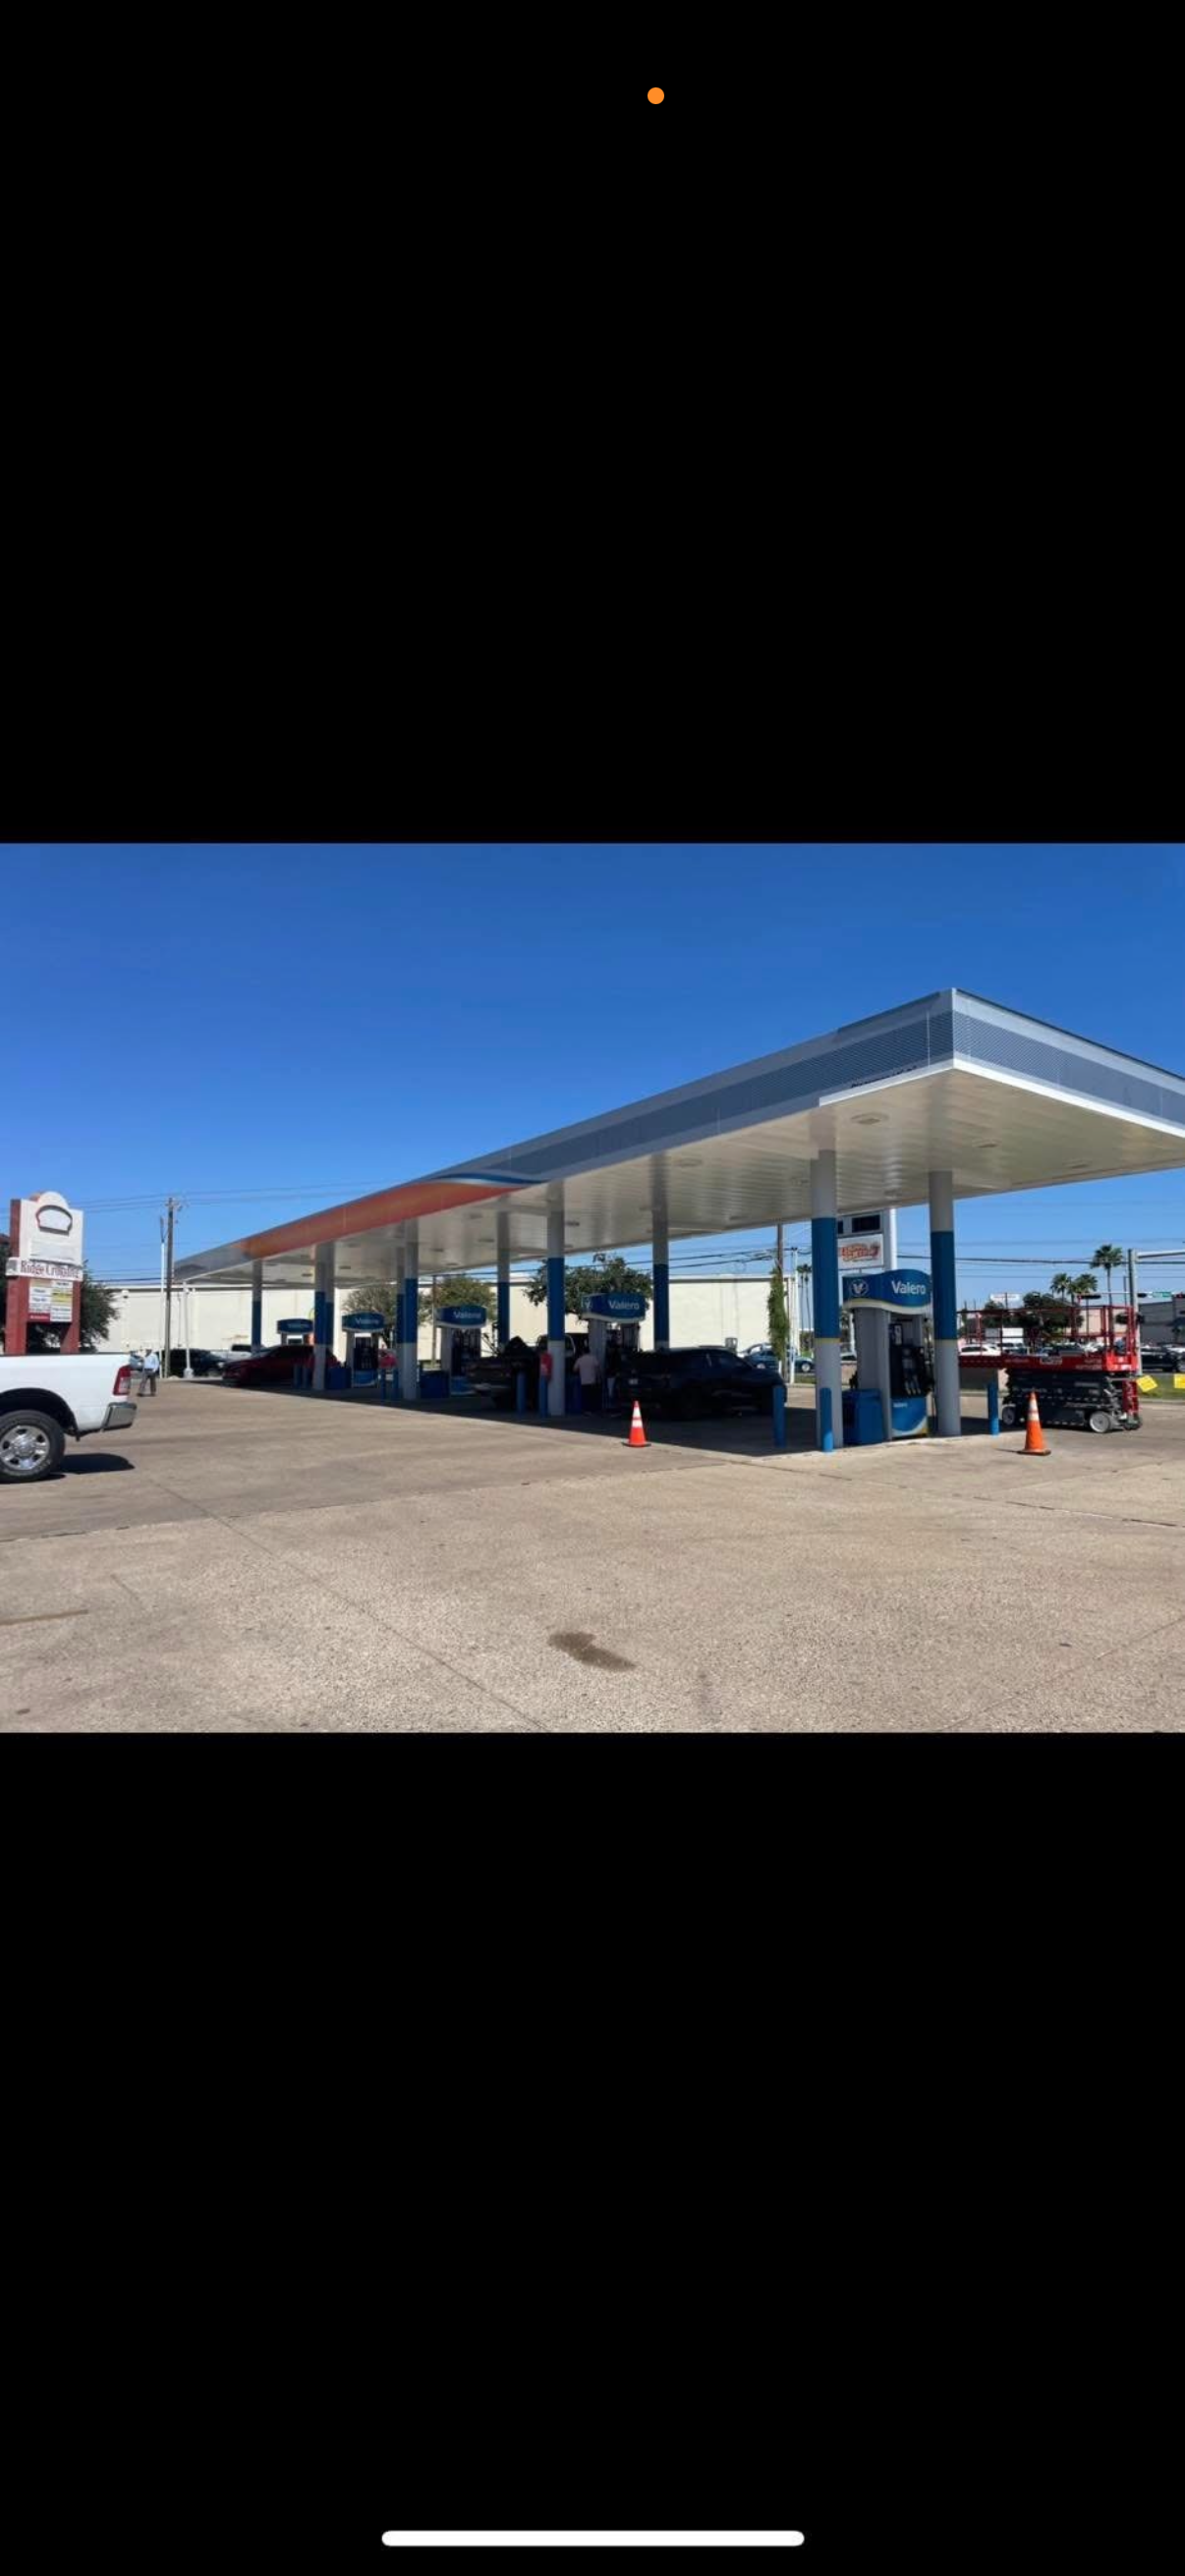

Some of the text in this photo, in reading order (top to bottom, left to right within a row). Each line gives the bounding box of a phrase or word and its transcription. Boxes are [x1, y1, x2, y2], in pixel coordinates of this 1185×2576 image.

[892, 1280, 927, 1295] Valero
[609, 1300, 640, 1311] Valero
[454, 1311, 481, 1319] Valero
